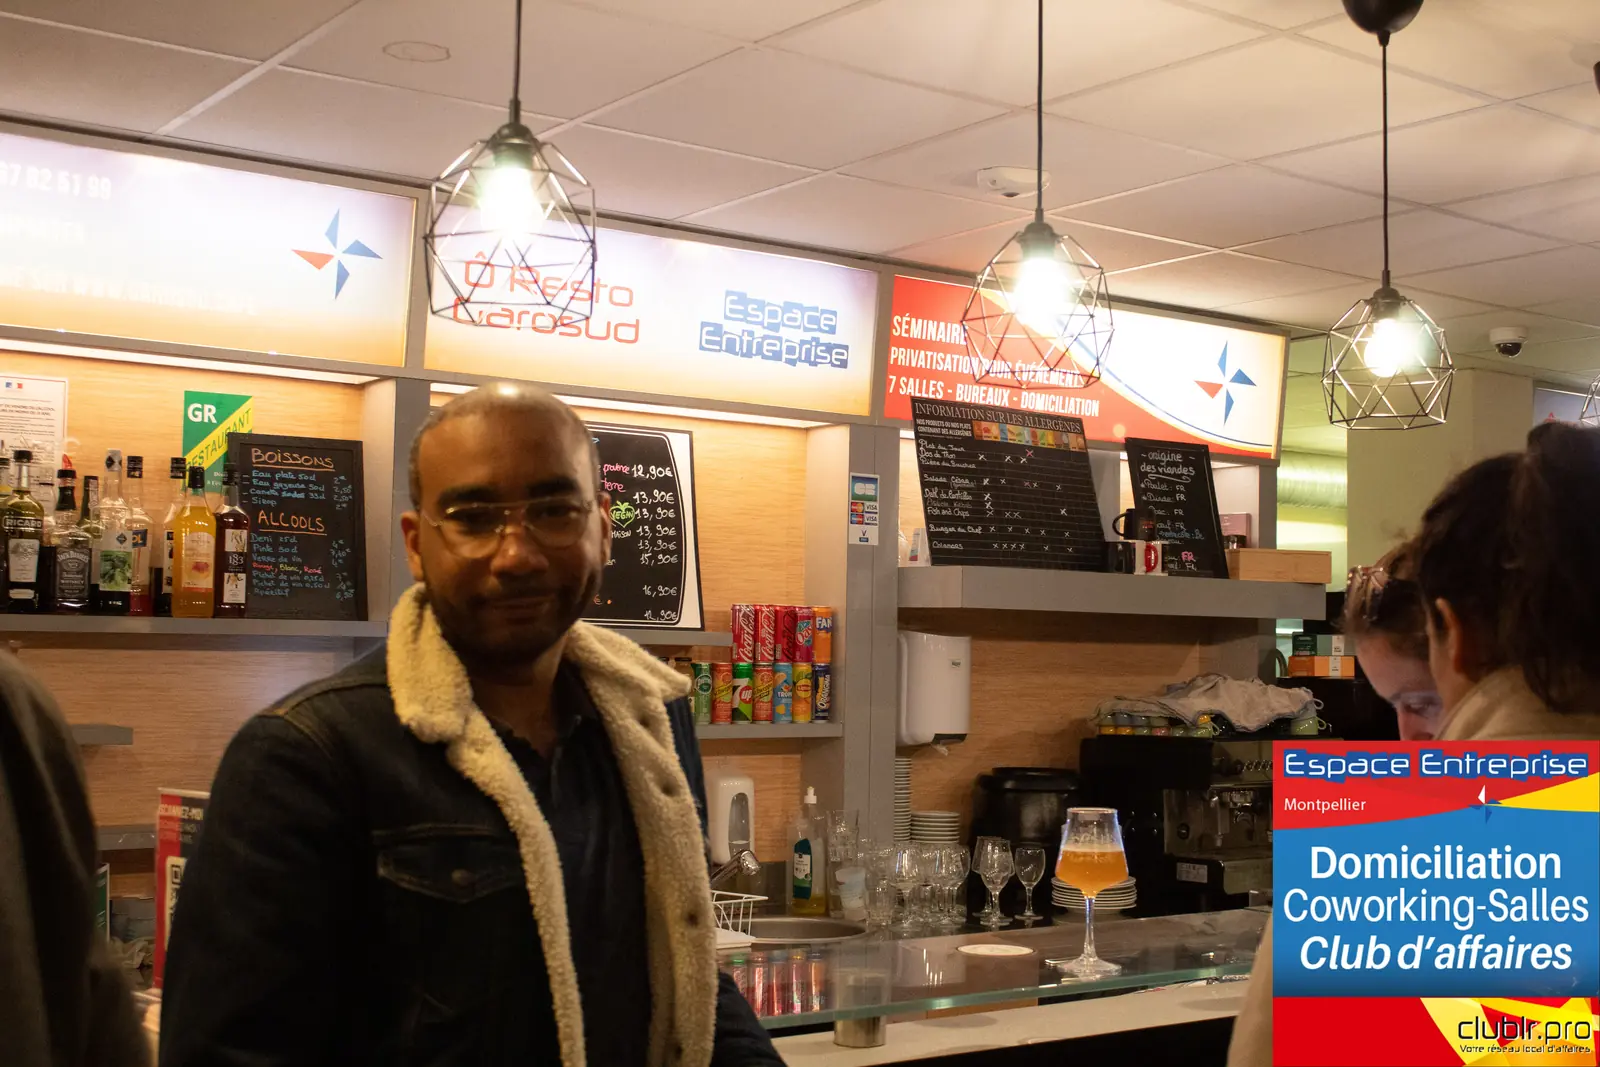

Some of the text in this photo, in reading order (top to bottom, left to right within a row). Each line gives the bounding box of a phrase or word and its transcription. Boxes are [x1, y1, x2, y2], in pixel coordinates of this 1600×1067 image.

[509, 265, 634, 307] Resto
[453, 296, 640, 344] Garosud
[725, 296, 837, 331] Espace
[702, 326, 848, 365] Entreprise
[890, 346, 983, 375] PRIVATISATION
[982, 358, 1012, 380] POUR
[888, 375, 897, 394] 7
[899, 378, 945, 399] SALLES
[956, 383, 1010, 407] BUREAUX
[1020, 391, 1099, 417] DOMICILIATION
[187, 403, 217, 423] GR
[915, 403, 985, 420] INFORMATION
[987, 410, 1006, 423] SUR
[1006, 413, 1024, 425] LES
[251, 447, 334, 468] BOISSONS
[1148, 450, 1183, 465] origine
[252, 470, 271, 478] Eau
[275, 470, 296, 480] plate
[603, 463, 673, 480] provence 12,90€
[1140, 463, 1196, 475] des viandes
[601, 478, 626, 492] terre
[633, 489, 675, 504] 13,90€
[1176, 493, 1186, 501] FR
[258, 510, 325, 532] ALCOOLS
[611, 507, 676, 521] VEGAN 13,90€
[6, 518, 42, 527] RICARD
[611, 524, 677, 539] MAISON 13,90€
[637, 539, 677, 553] 13,90€
[640, 553, 679, 566] 15,90€
[1182, 551, 1197, 562] FR
[642, 585, 678, 597] 16,90€
